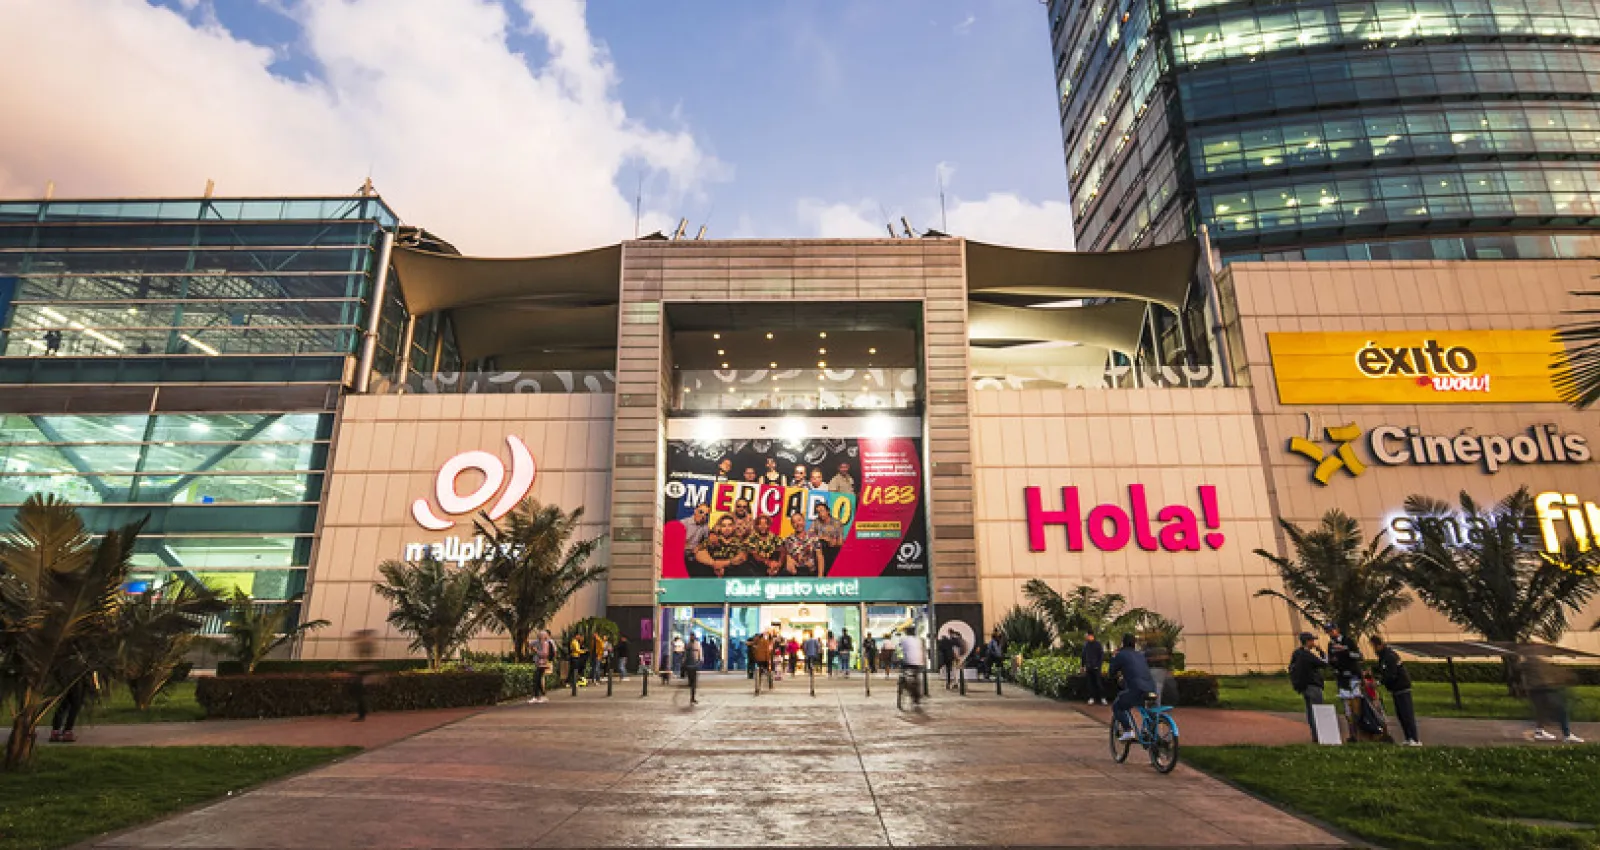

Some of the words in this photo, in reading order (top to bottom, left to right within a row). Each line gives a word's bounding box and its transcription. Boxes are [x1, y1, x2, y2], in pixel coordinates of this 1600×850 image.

[1355, 340, 1477, 378] éxito
[1432, 374, 1490, 392] wow!
[1369, 423, 1592, 473] Cinépolis
[1024, 483, 1225, 553] Hola!
[1391, 515, 1524, 547] sma
[765, 582, 813, 600] gusto
[814, 579, 859, 596] verte!
